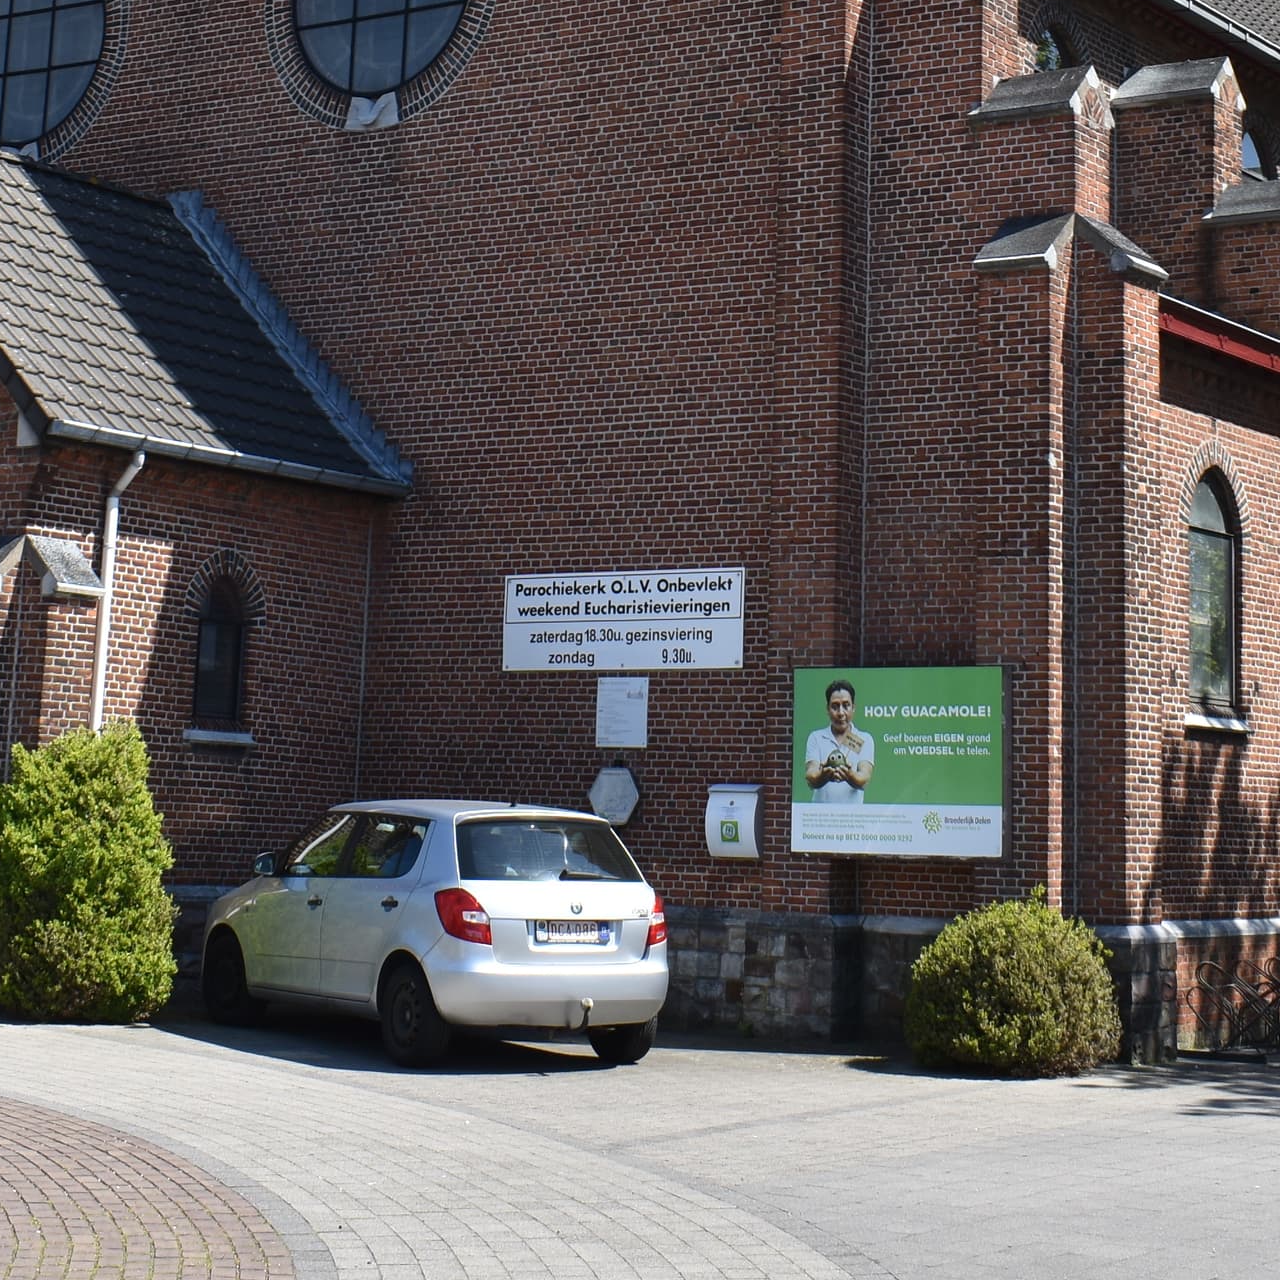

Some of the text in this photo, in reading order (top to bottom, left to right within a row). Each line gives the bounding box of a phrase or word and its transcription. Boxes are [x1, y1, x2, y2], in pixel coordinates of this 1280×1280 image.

[516, 576, 733, 597] Parochiekerk O.L.V. Onbevlekt
[518, 598, 730, 617] weekend Eucharistievieringen
[530, 627, 713, 646] zaterdag 18.30u. gezinsviering
[548, 649, 696, 667] zondag 9.30u.
[864, 705, 991, 717] HOLY GUACAMOLE!
[883, 733, 991, 744] Geef boeren EIGEN grond
[893, 746, 991, 756] om VOEDSEL te telen.
